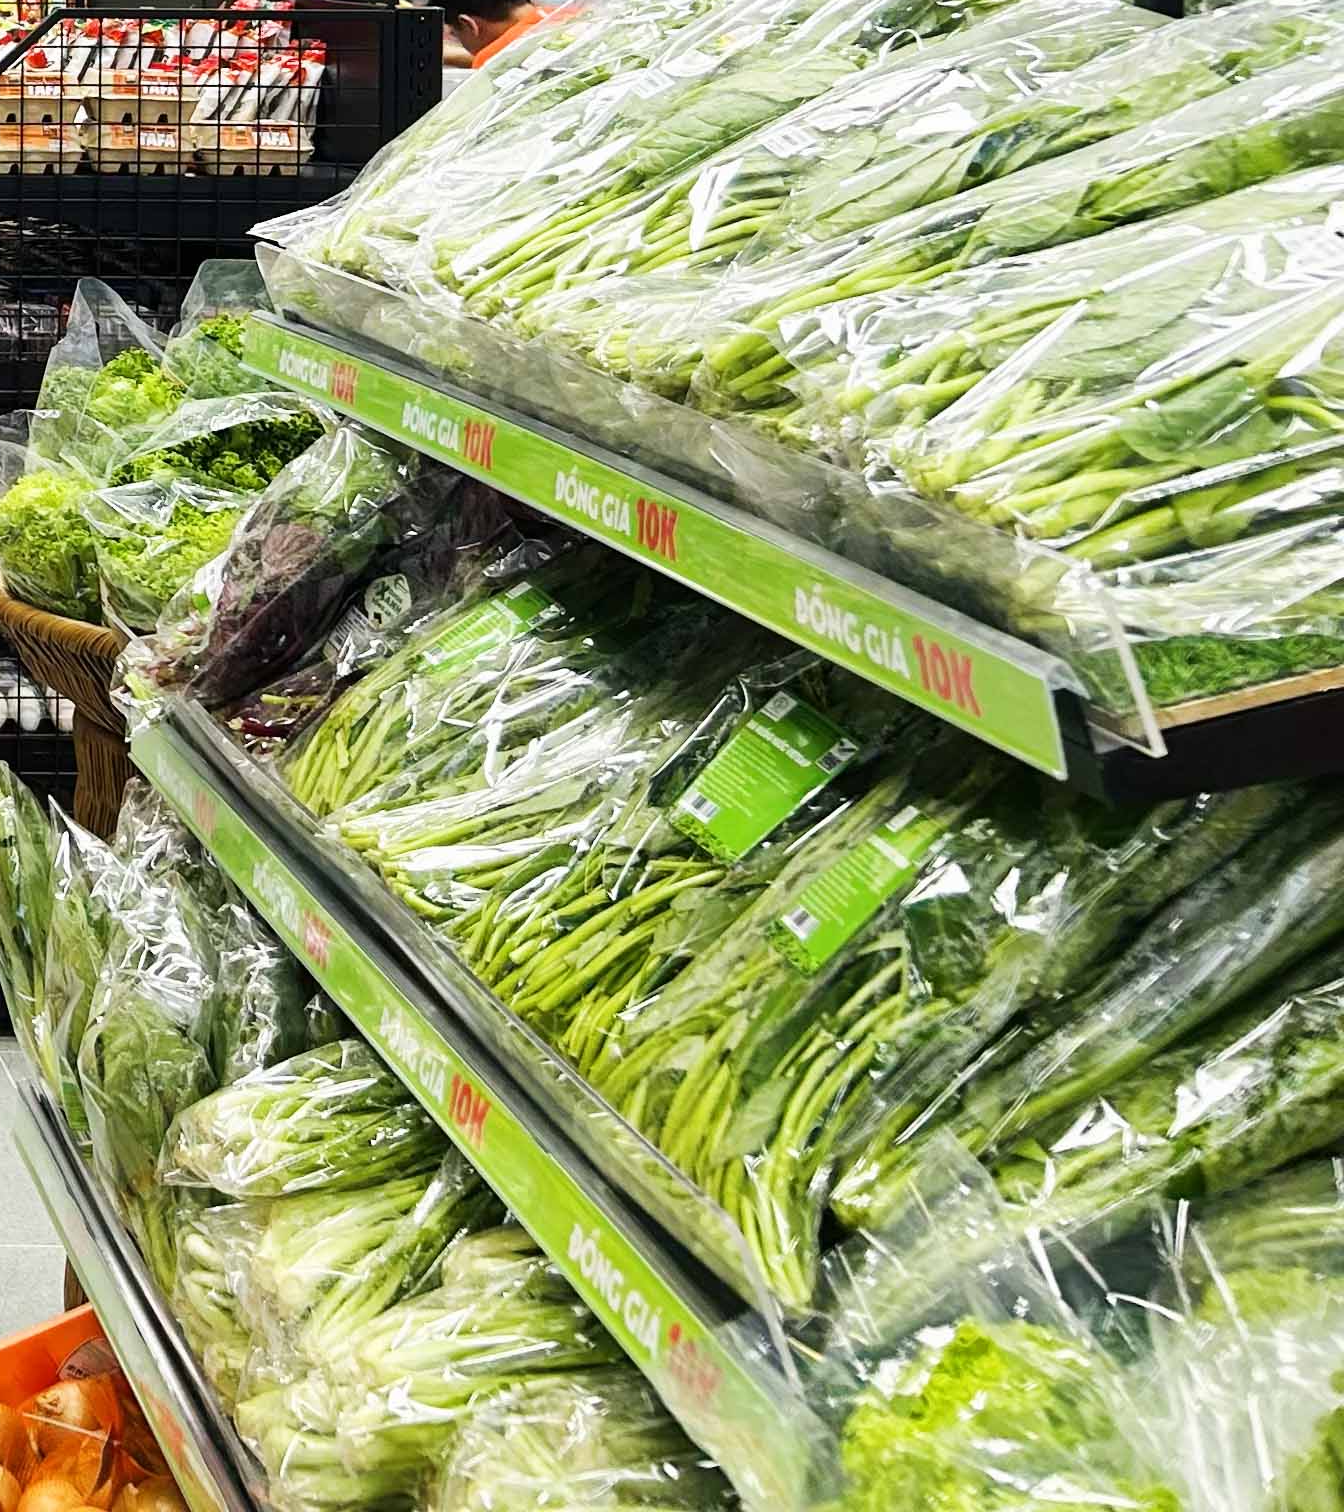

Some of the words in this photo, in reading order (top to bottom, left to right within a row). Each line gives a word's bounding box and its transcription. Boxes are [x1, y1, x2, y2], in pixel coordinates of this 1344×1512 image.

[139, 131, 177, 148] TAFA
[252, 131, 292, 147] TAFA
[330, 359, 360, 406] 10K
[463, 418, 496, 472] 10K
[554, 464, 600, 521] ĐỒNG
[601, 489, 631, 536] GIÁ
[635, 496, 679, 562] 10K
[794, 582, 862, 655] ĐỒNG
[864, 623, 911, 681] GIÁ
[913, 633, 982, 718] 10K
[448, 1072, 492, 1145] 10K
[624, 1289, 662, 1360] GIÁ
